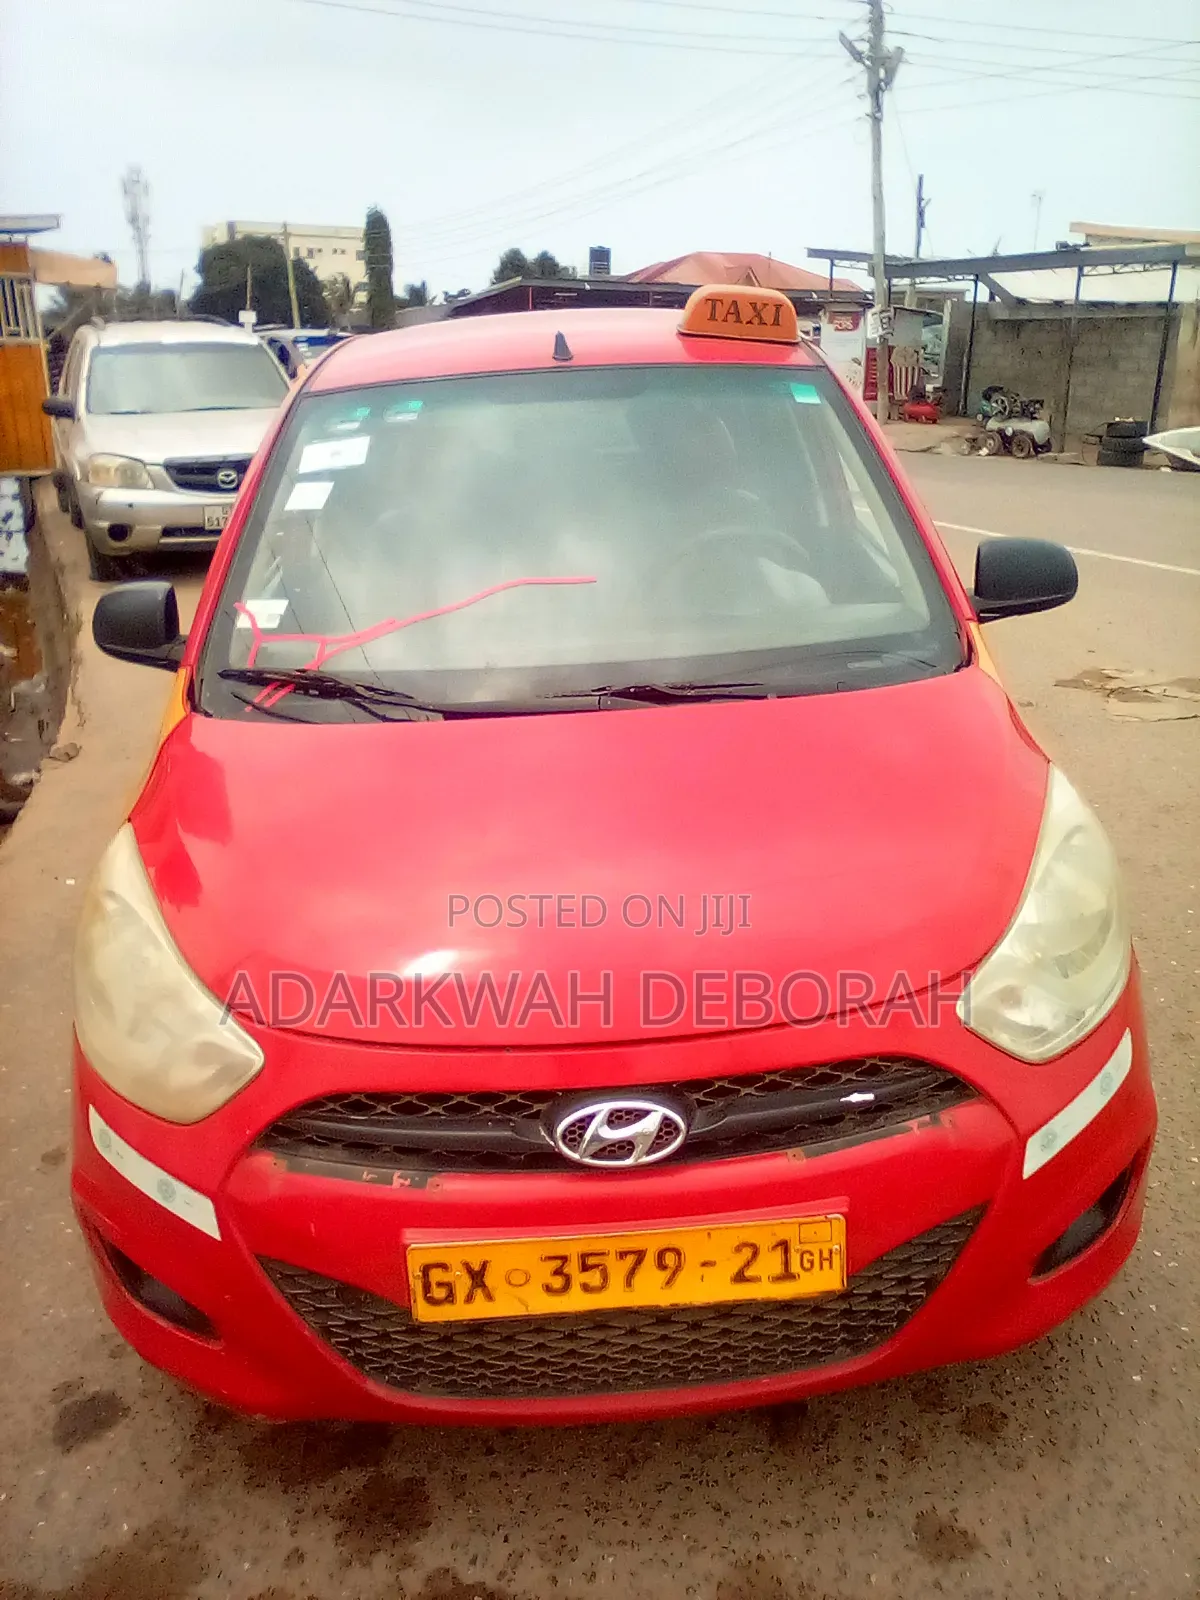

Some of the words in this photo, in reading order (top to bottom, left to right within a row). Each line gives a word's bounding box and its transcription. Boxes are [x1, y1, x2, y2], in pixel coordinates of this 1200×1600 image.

[705, 298, 784, 326] TAXI
[420, 1260, 496, 1306] GX
[800, 1248, 833, 1272] GH
